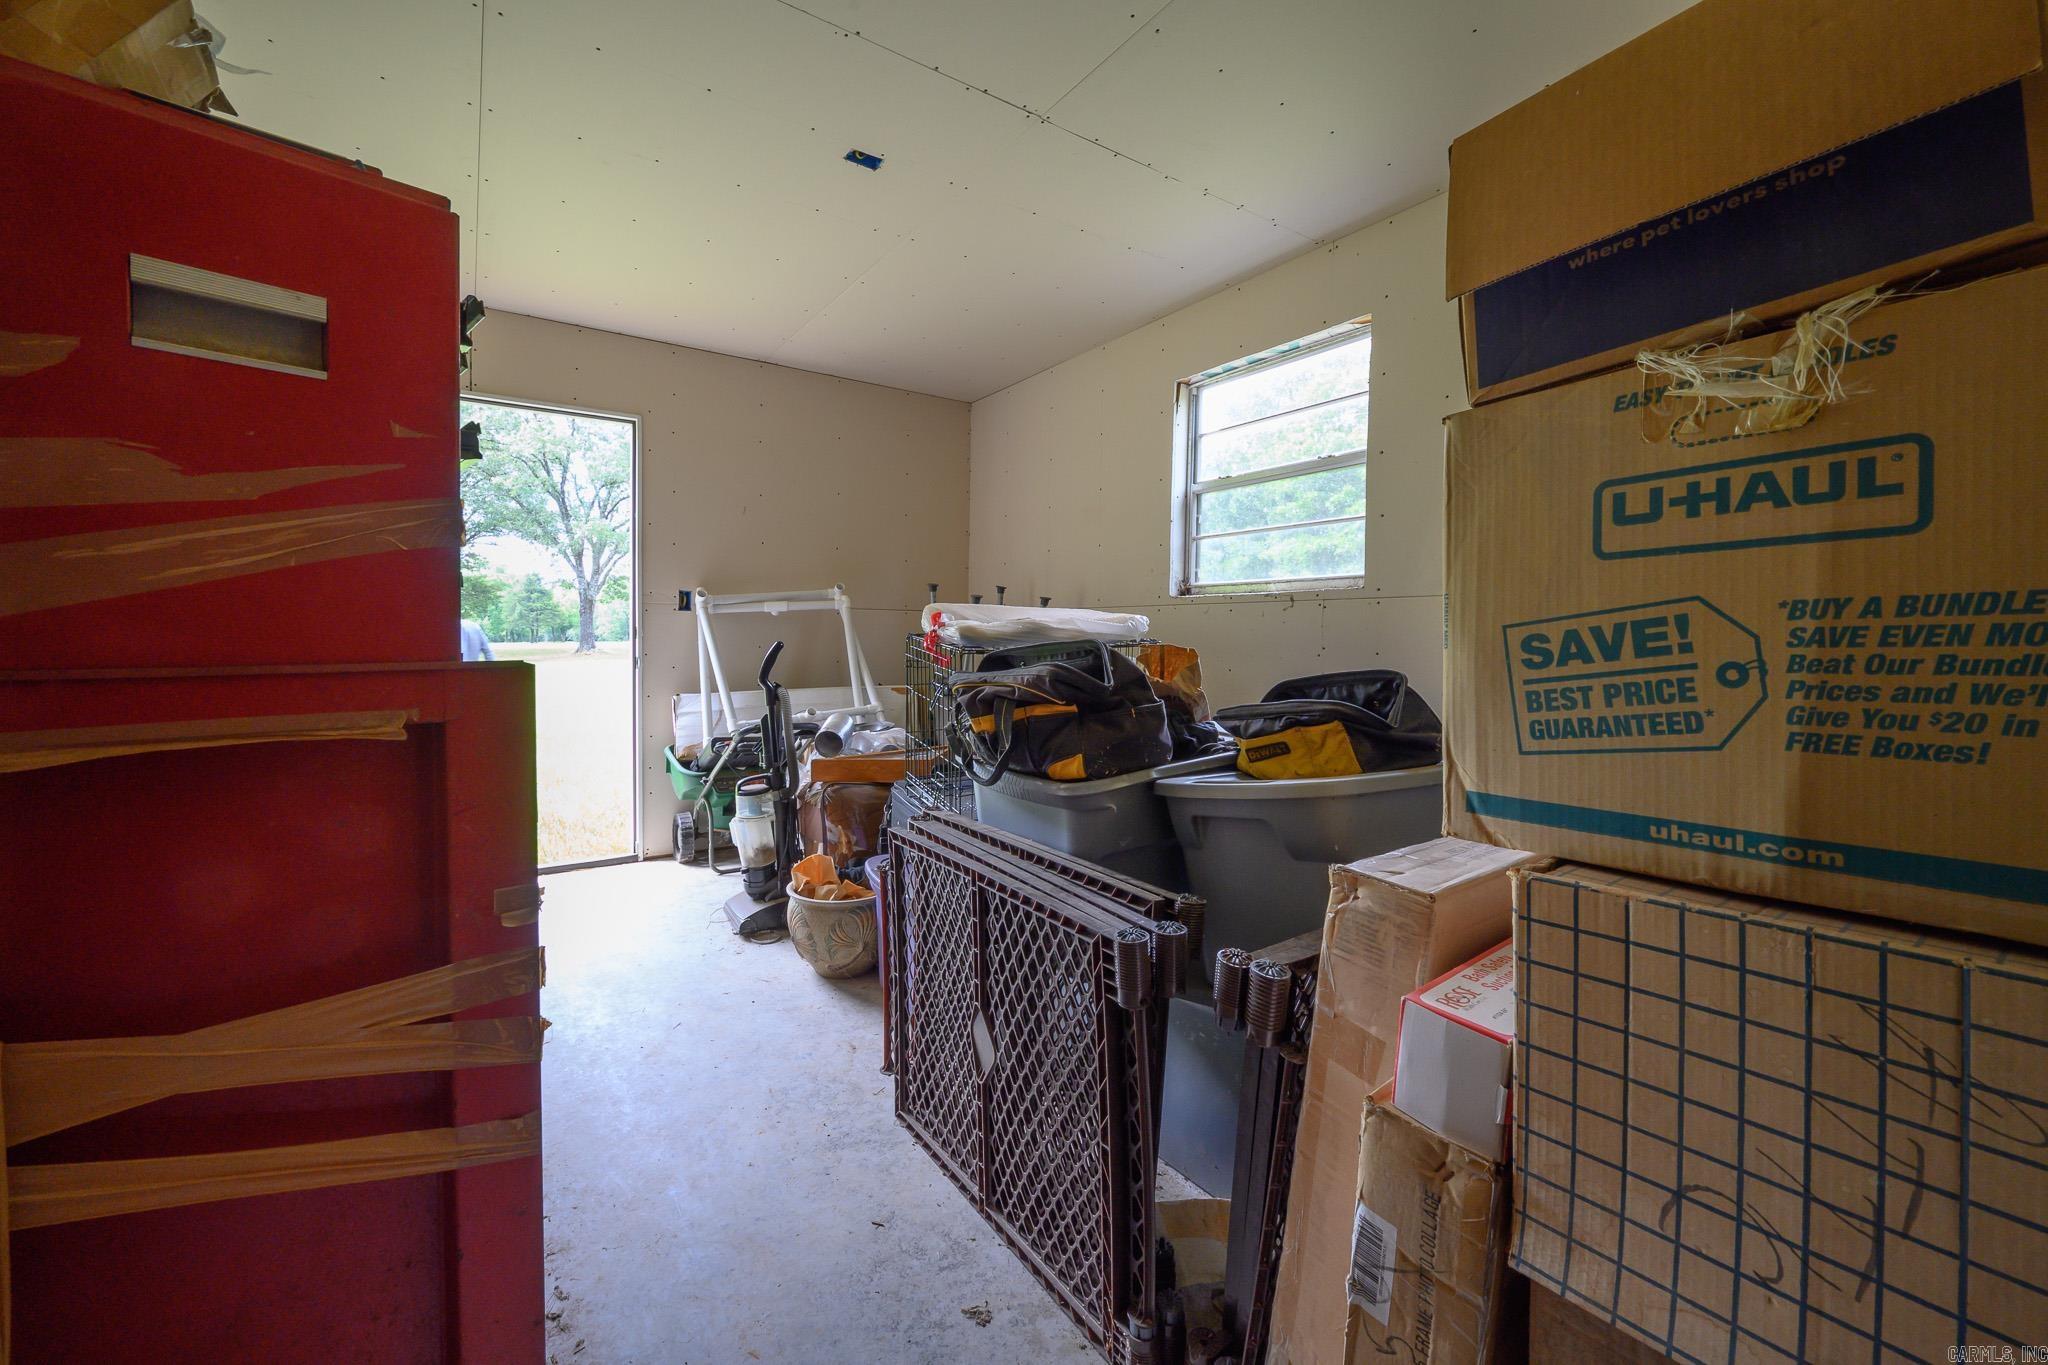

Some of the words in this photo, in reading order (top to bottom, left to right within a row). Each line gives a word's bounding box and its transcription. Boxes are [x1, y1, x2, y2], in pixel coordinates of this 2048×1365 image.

[1567, 235, 1636, 270] where
[1641, 215, 1682, 247] pet
[1687, 186, 1768, 226] lovers
[1775, 155, 1846, 192] shop
[1613, 385, 1670, 413] EASY
[1858, 595, 1883, 619] A
[1894, 588, 2048, 618] BUNDLE
[1519, 613, 1695, 671] SAVE!
[1786, 625, 1870, 649] SAVE
[1877, 623, 1975, 648] EVEN
[1786, 654, 1856, 675] Beat
[1864, 653, 1925, 676] Our
[1524, 685, 1593, 713] BEST
[1602, 677, 1699, 708] PRICE
[1786, 680, 1881, 702] Prices
[1890, 682, 1958, 704] and
[1786, 706, 1850, 728] Give
[1861, 708, 1921, 731] You
[1929, 711, 1989, 735] $20
[2001, 713, 2040, 738] in
[1784, 732, 1864, 757] FREE
[1870, 735, 1992, 765] Boxes!
[1649, 824, 1845, 868] uhaul.com
[1461, 968, 1490, 982] Bath
[1419, 1190, 1442, 1258] COLLAGE
[1414, 1307, 1434, 1358] FRAME
